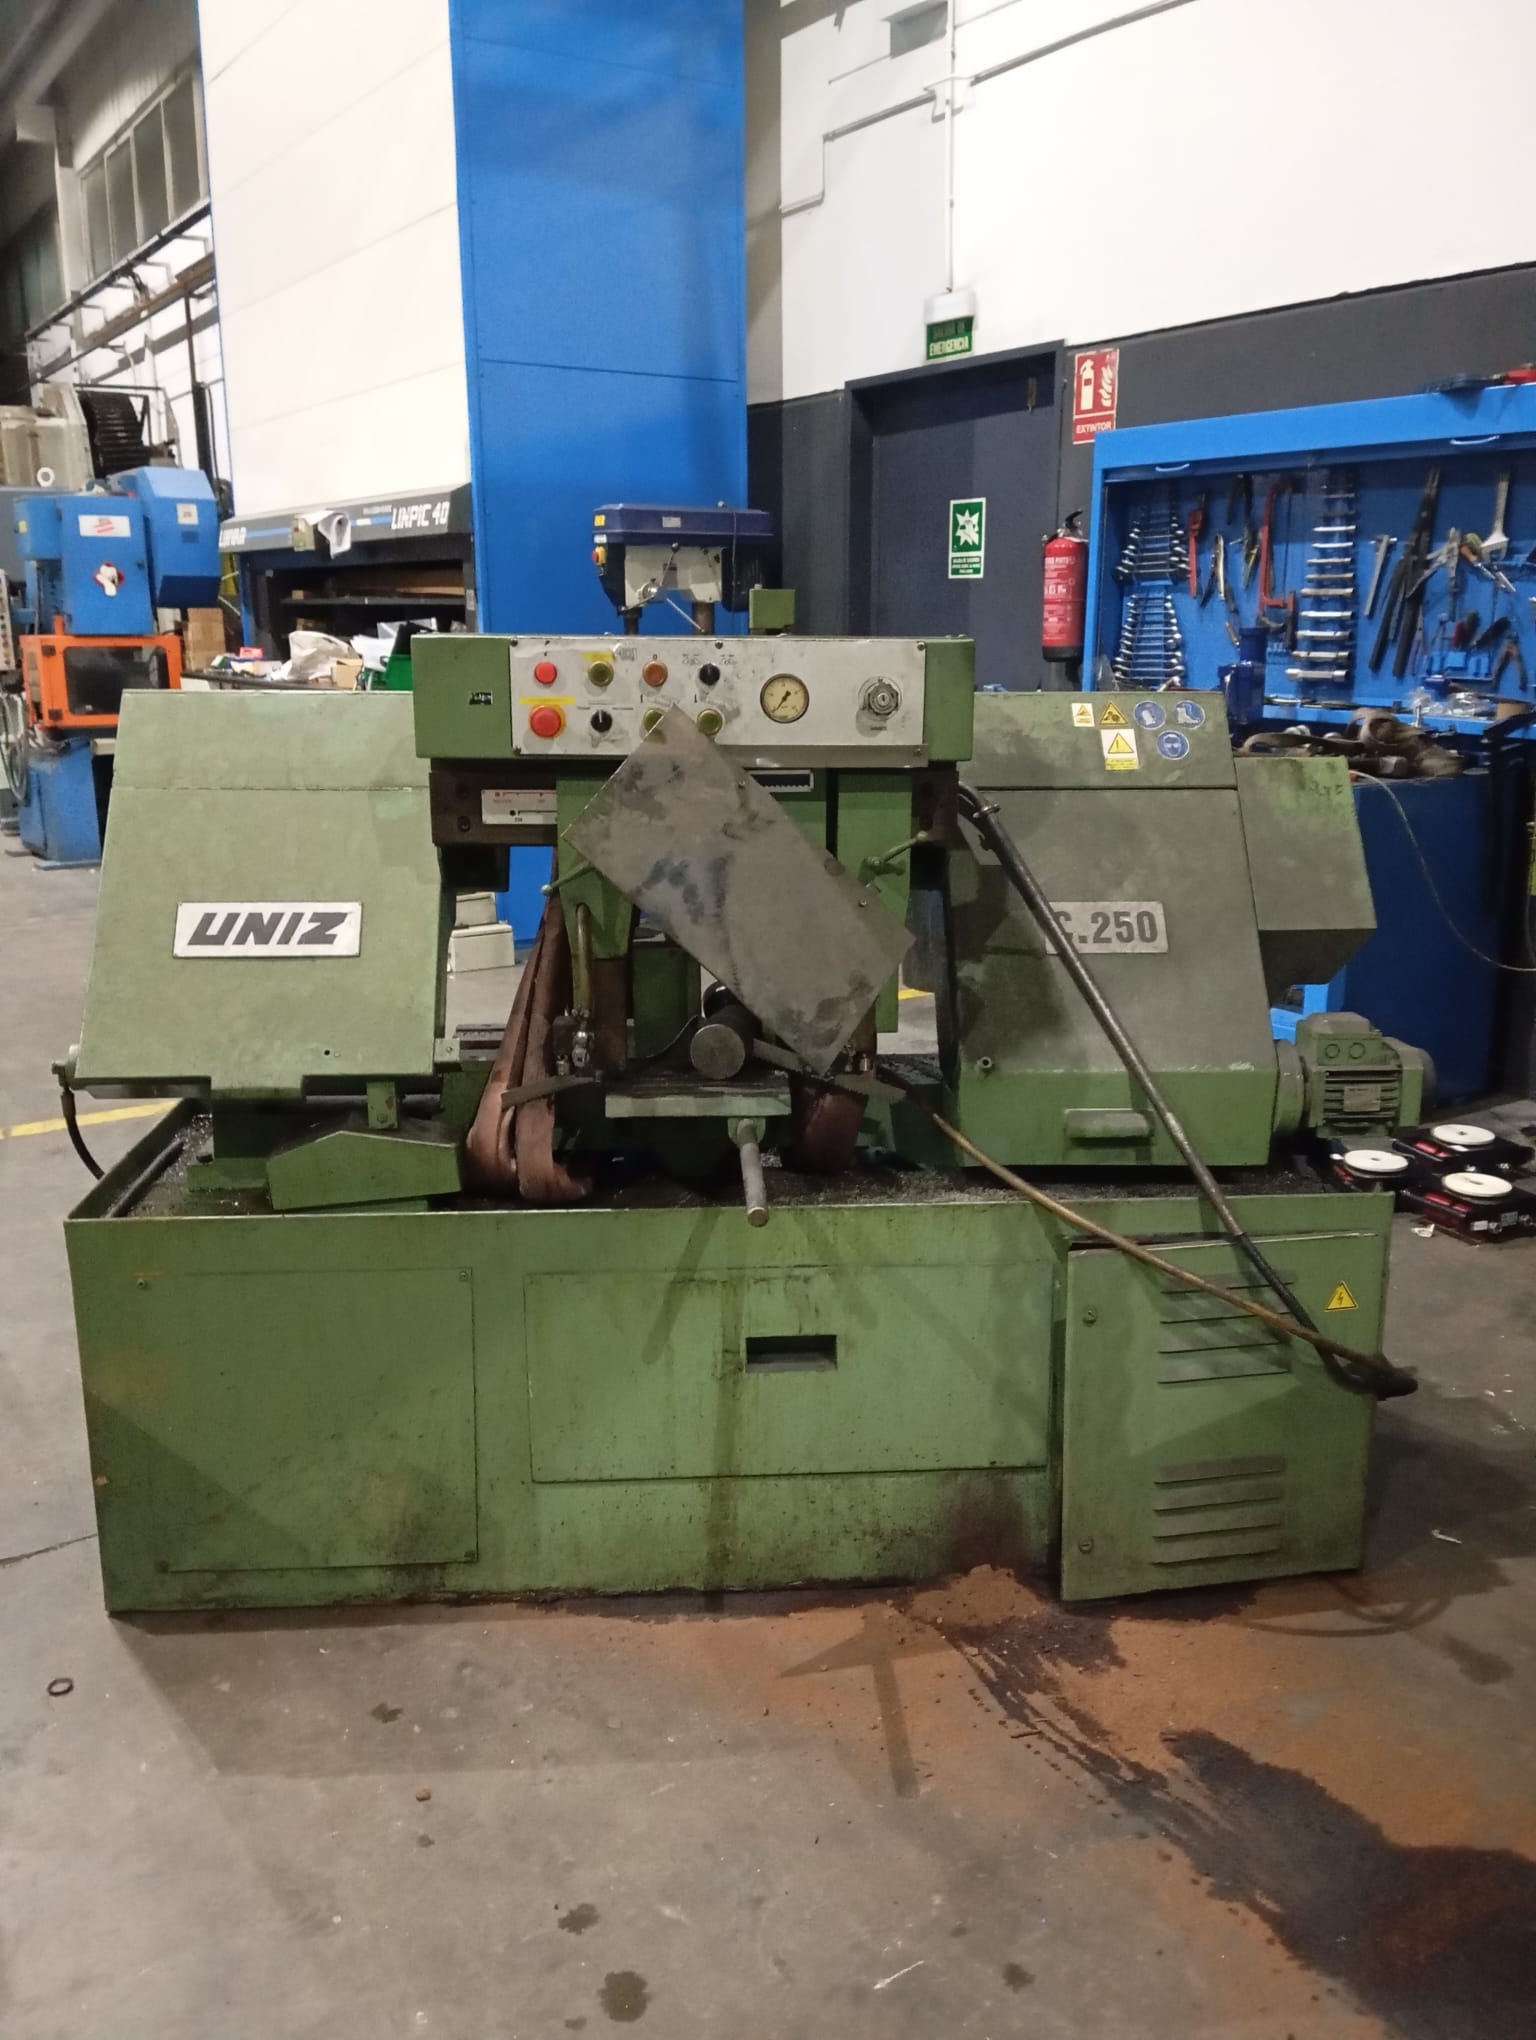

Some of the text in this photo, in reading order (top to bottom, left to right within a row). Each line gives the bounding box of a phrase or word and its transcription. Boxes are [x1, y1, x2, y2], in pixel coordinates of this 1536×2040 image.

[929, 335, 969, 357] EMERGENCIA
[1076, 421, 1112, 434] EXTINTOR
[391, 503, 432, 530] LINPIC
[431, 500, 450, 526] 40
[187, 911, 349, 946] UNIZ
